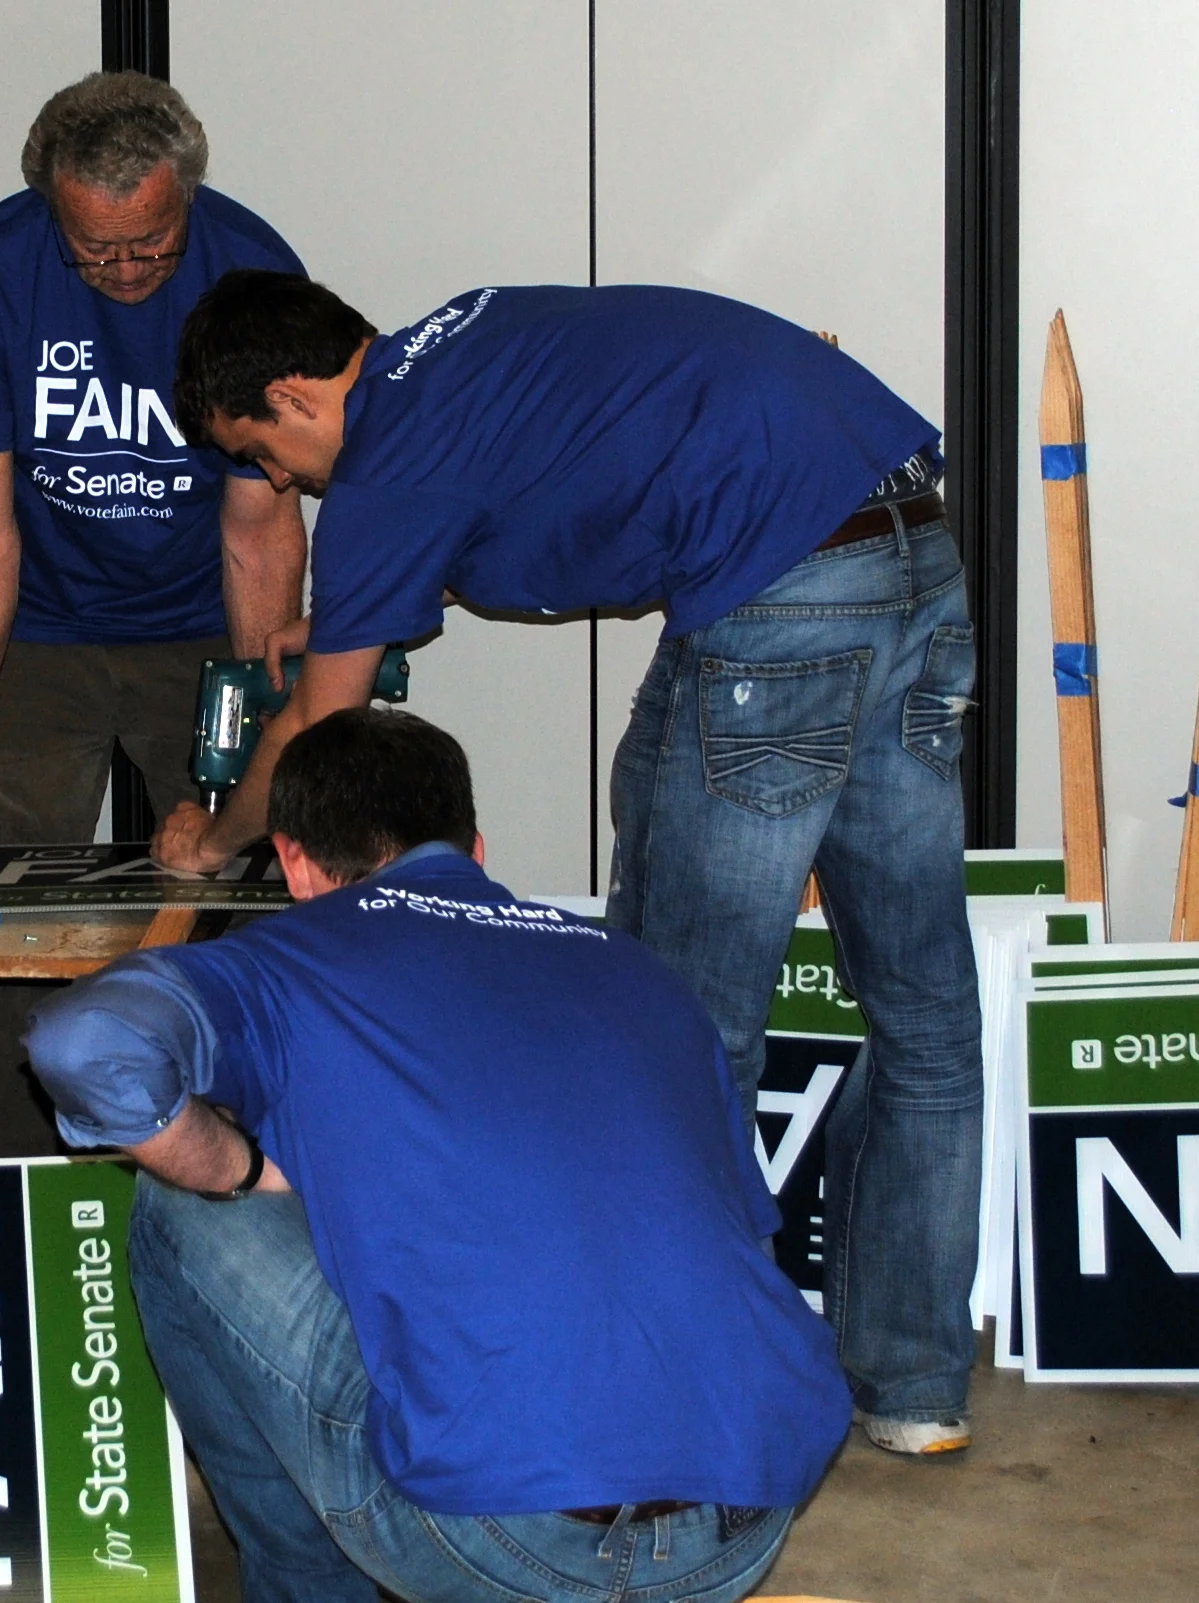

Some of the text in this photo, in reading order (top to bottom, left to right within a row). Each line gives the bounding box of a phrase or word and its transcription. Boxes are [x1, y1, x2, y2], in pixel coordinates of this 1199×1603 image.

[37, 340, 94, 372] JOE
[387, 360, 414, 381] for
[32, 465, 62, 489] for
[65, 465, 166, 500] Senate
[42, 491, 174, 520] www.votefain.com
[357, 898, 609, 941] for Our Community
[375, 886, 564, 922] Working Hard
[71, 1237, 121, 1387] Senate
[79, 1395, 129, 1516] State
[93, 1522, 148, 1578] for
